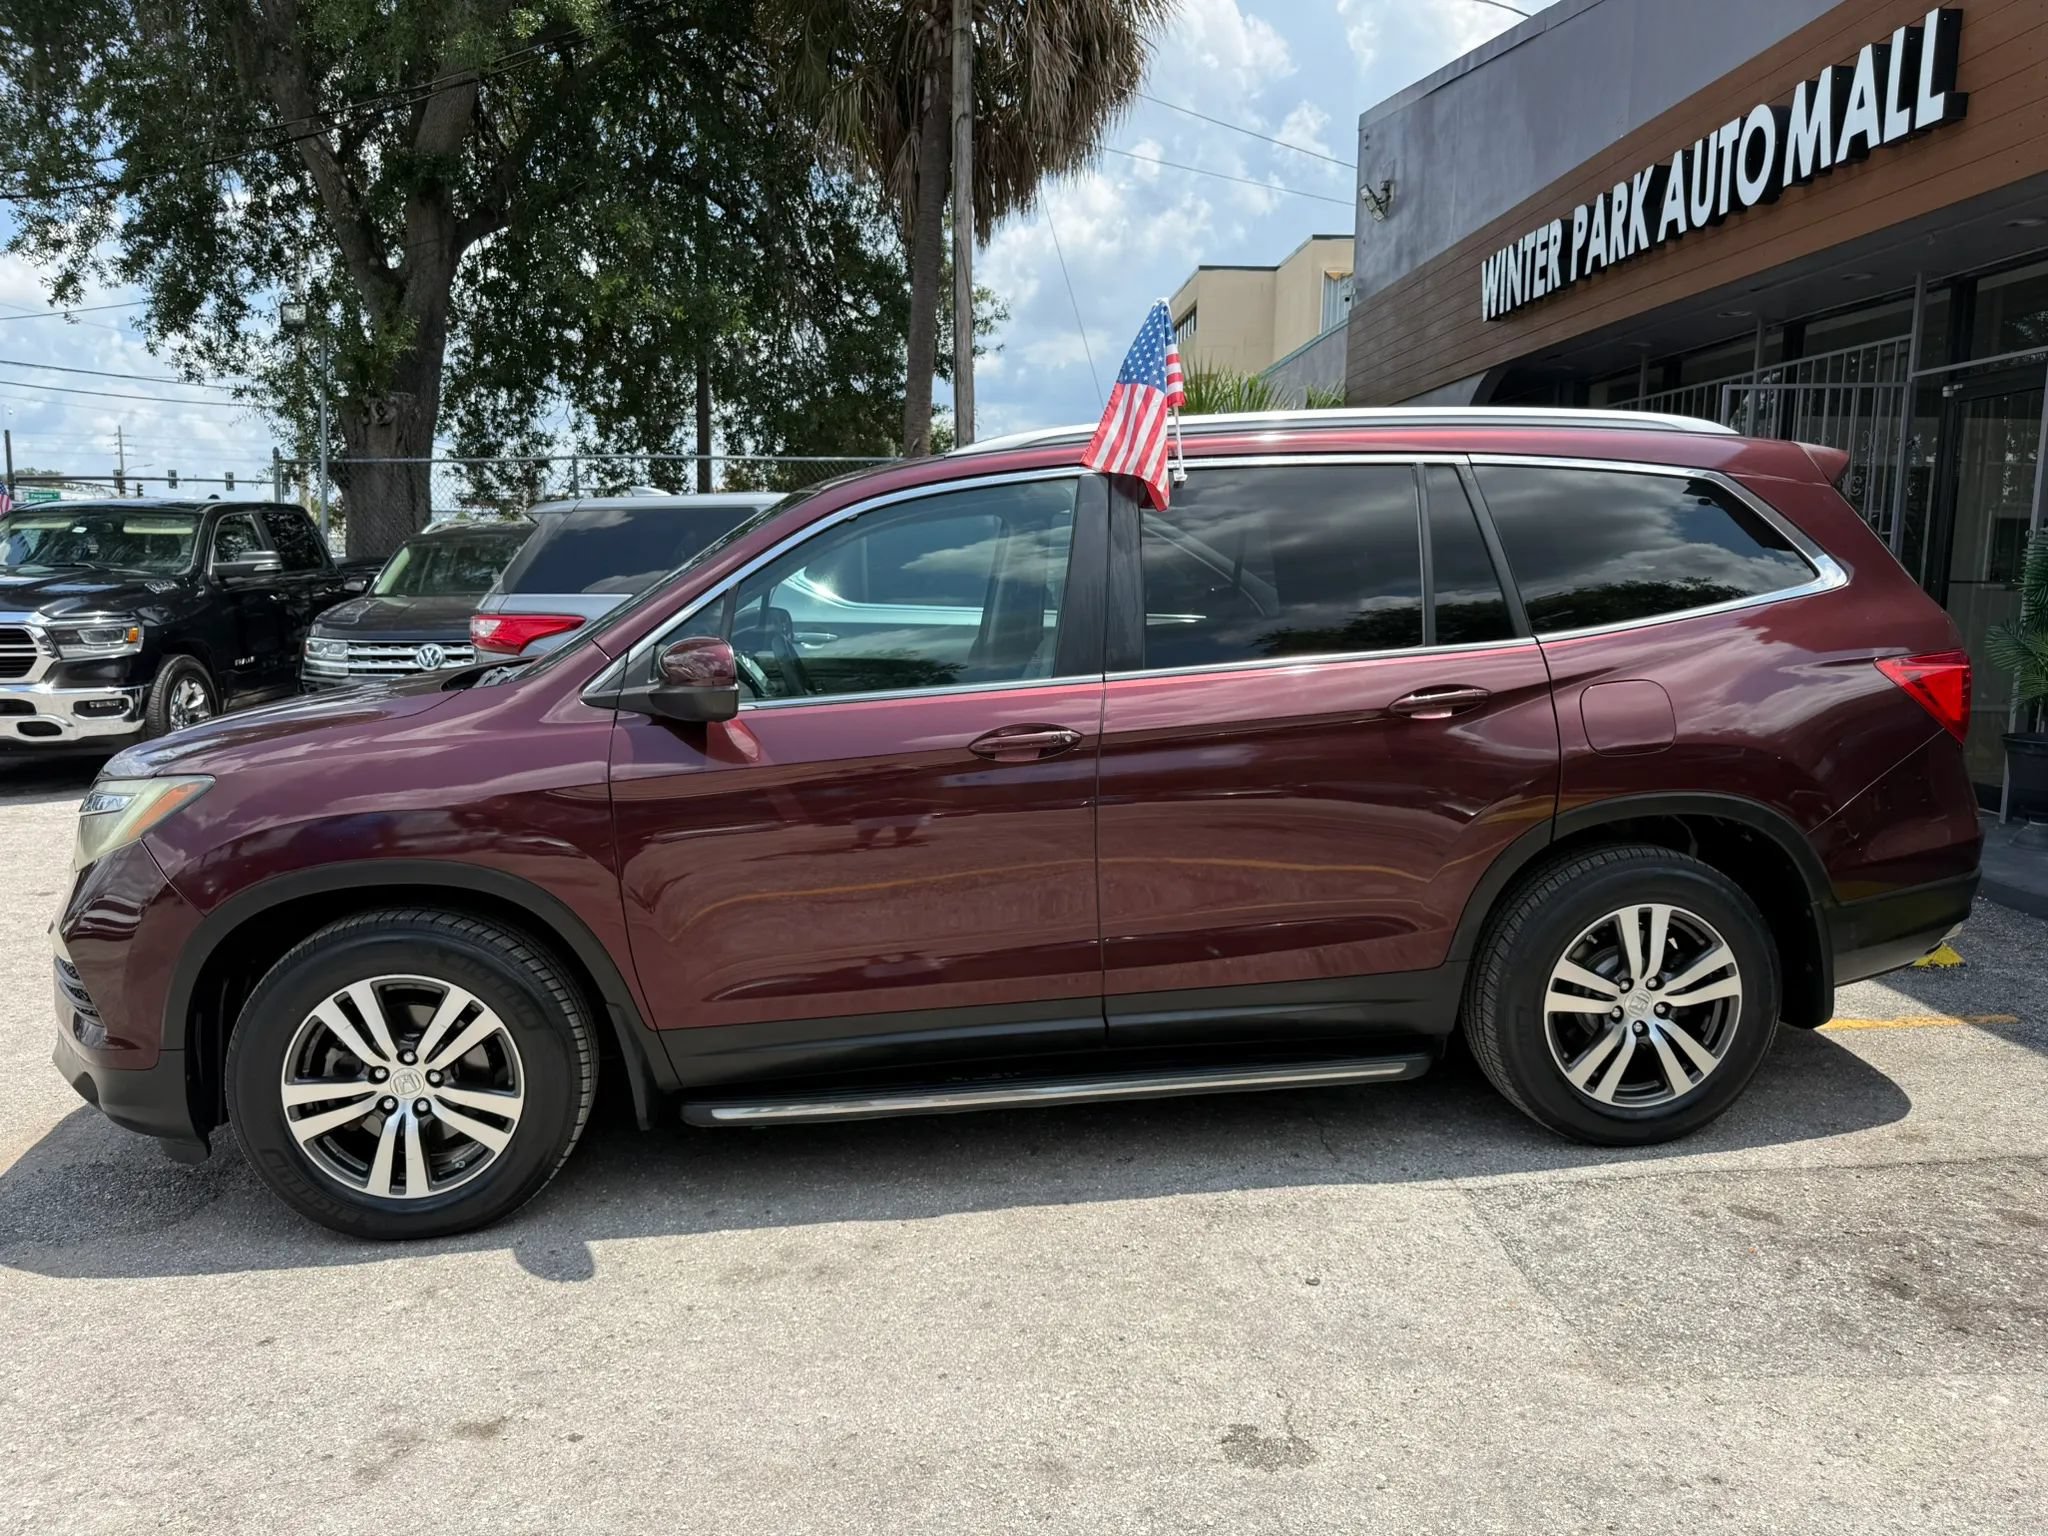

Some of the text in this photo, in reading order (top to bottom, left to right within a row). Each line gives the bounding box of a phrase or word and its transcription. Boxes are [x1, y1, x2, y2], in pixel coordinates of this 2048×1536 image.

[1481, 7, 1949, 323] WINTER PARK AUTO MALL
